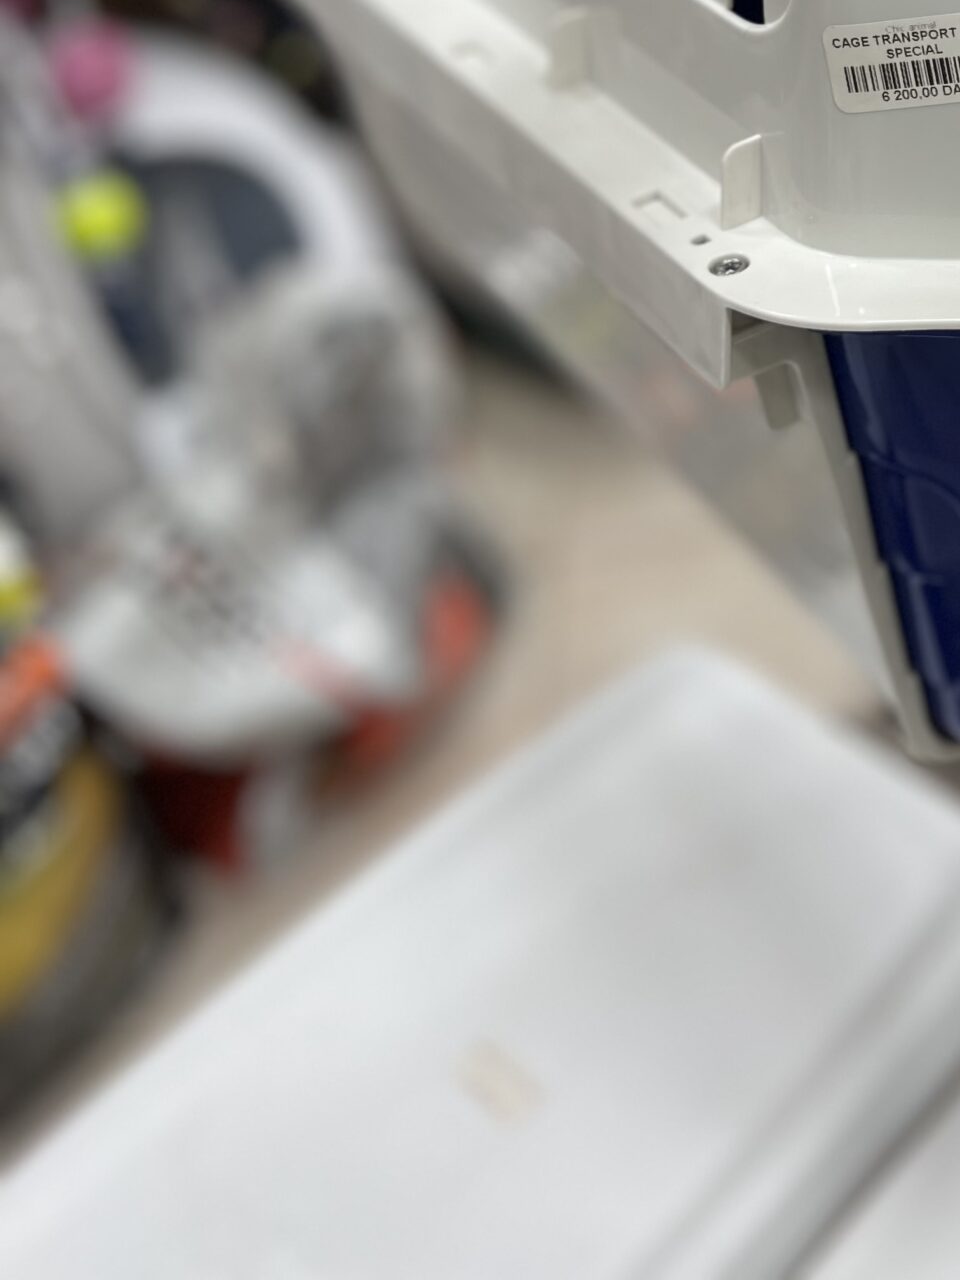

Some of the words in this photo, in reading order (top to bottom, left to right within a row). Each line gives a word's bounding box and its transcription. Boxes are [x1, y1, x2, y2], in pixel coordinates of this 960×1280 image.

[832, 36, 870, 49] CAGE
[872, 27, 957, 46] TRANSPORT
[886, 44, 943, 59] SPECIAL
[882, 91, 890, 102] 6
[895, 86, 938, 101] 200,00
